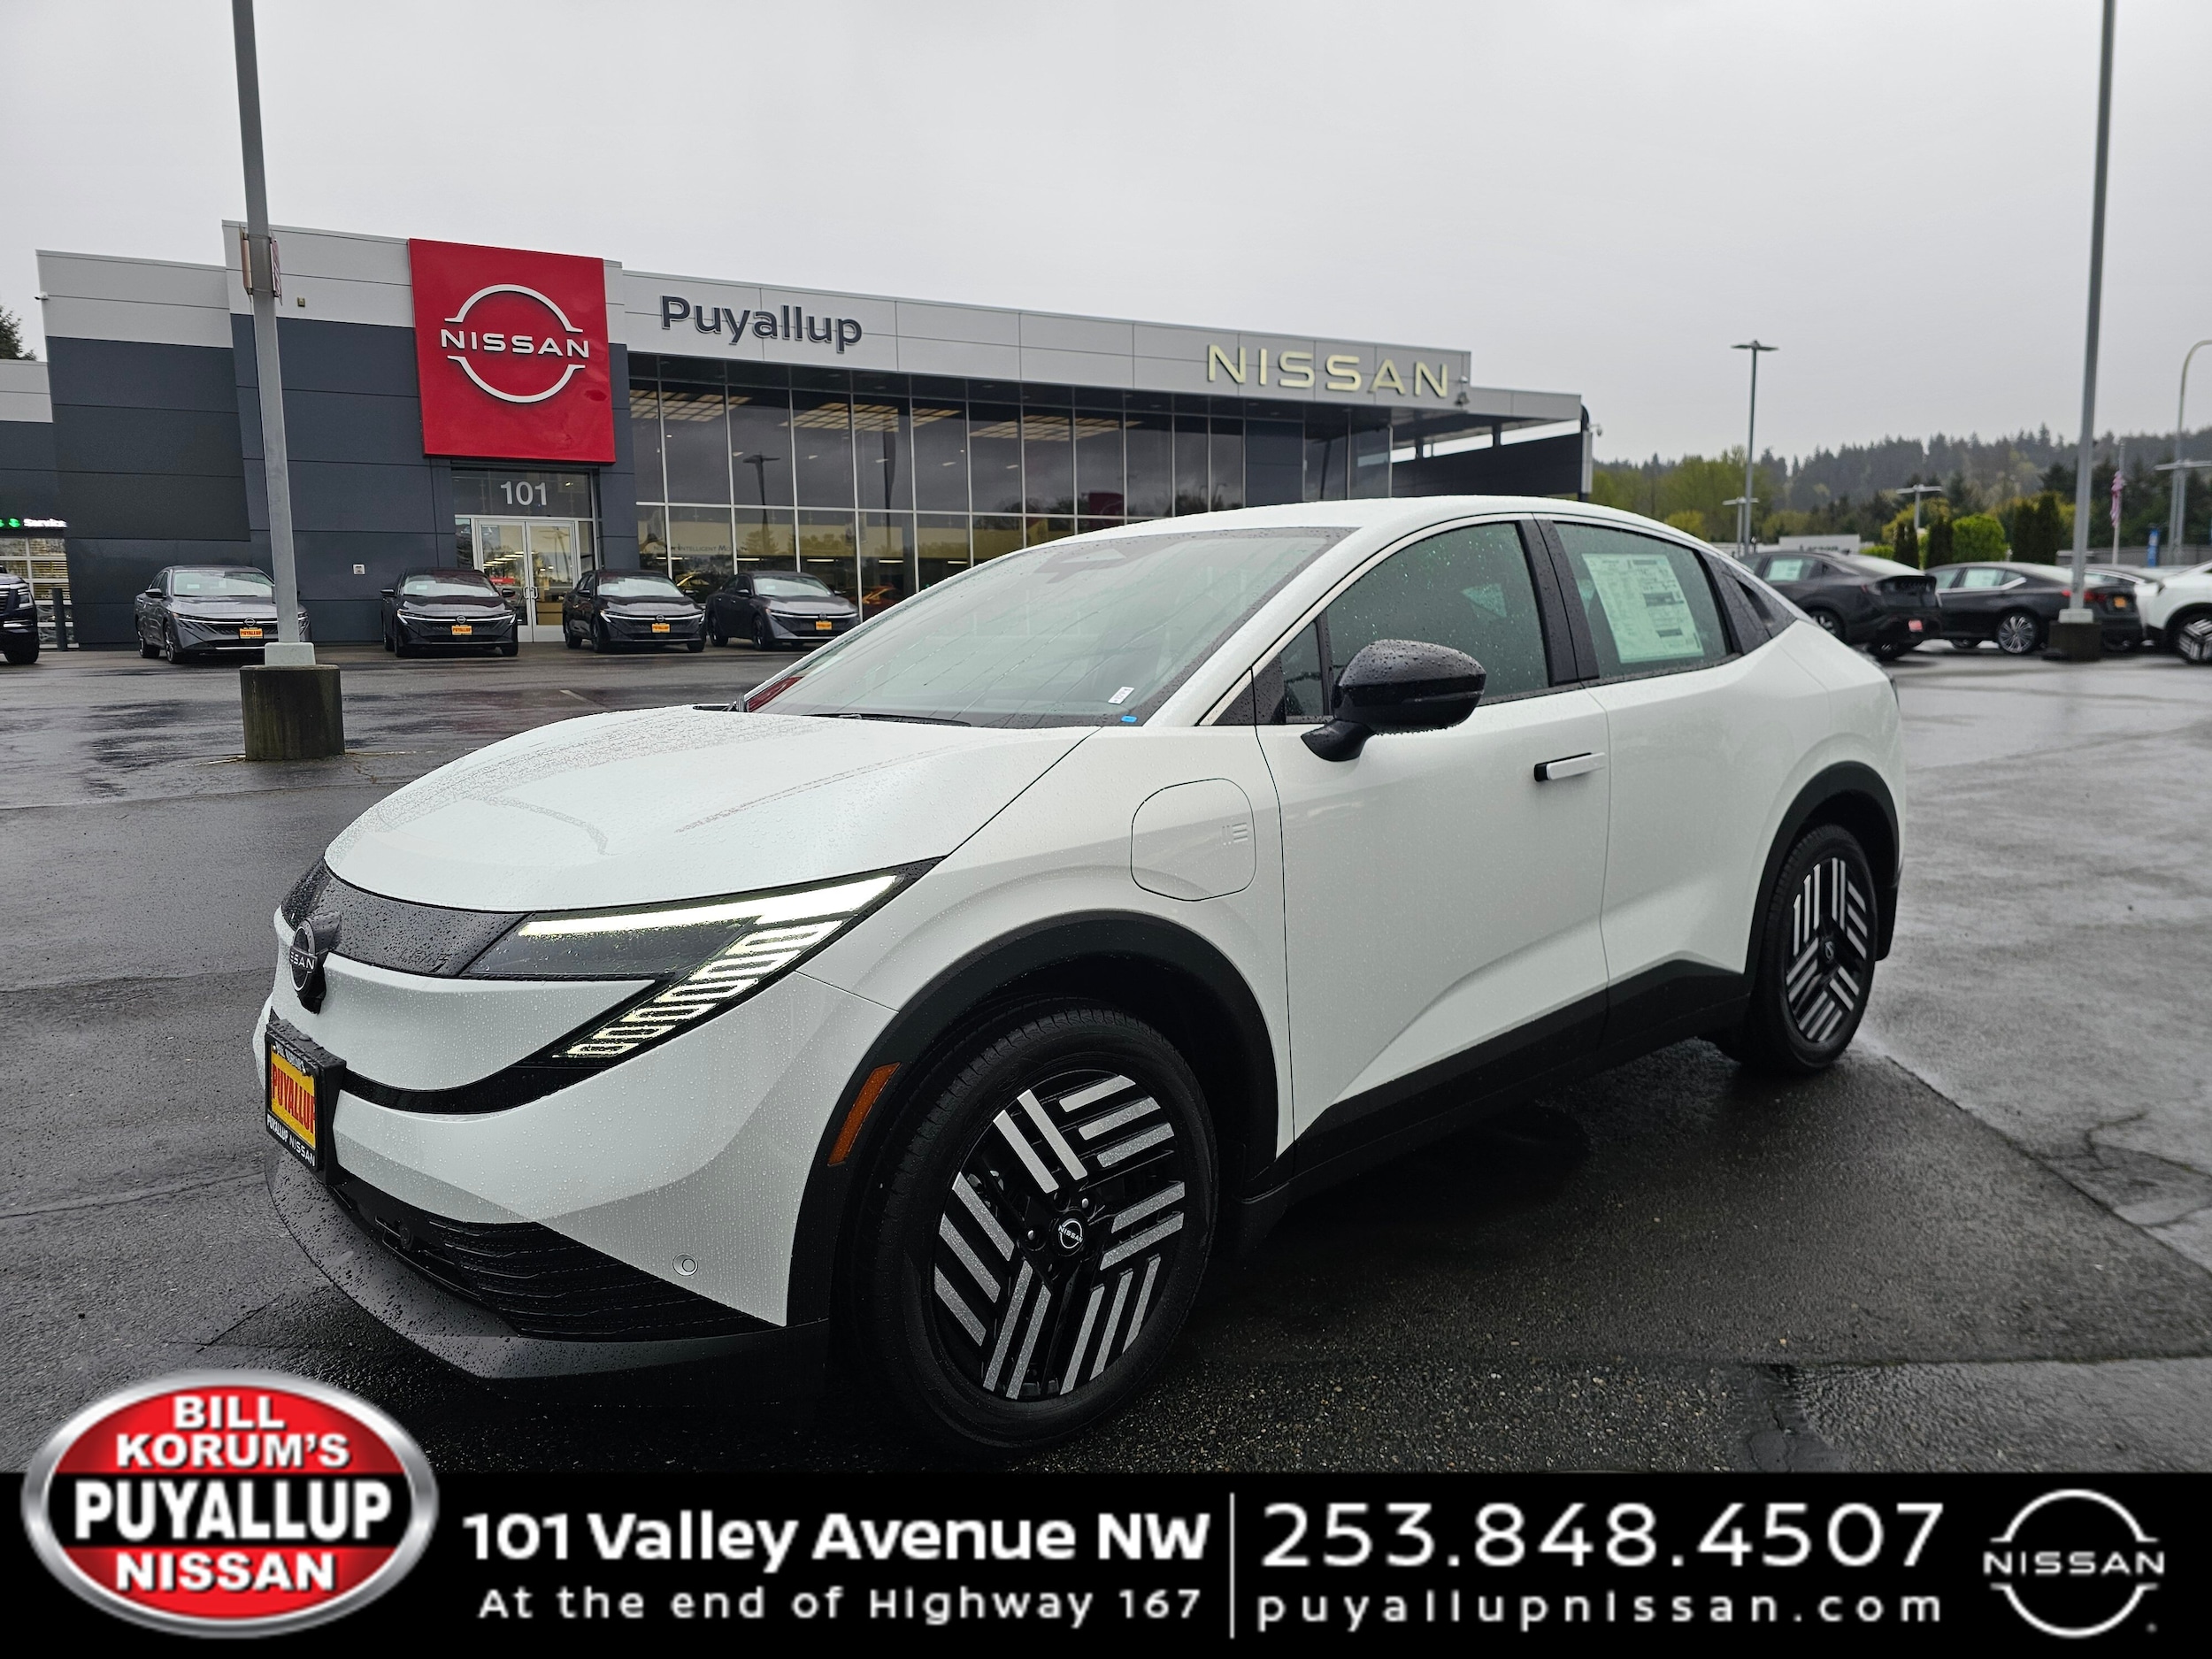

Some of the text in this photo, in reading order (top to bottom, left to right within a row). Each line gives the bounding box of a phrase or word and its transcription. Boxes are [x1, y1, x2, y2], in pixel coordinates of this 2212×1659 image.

[661, 295, 863, 353] Puyallup
[441, 328, 590, 358] NISSAN
[1207, 344, 1449, 398] NISSAN
[500, 480, 548, 506] 101
[289, 1134, 316, 1167] NISSAN
[1058, 1225, 1083, 1243] NISSAN
